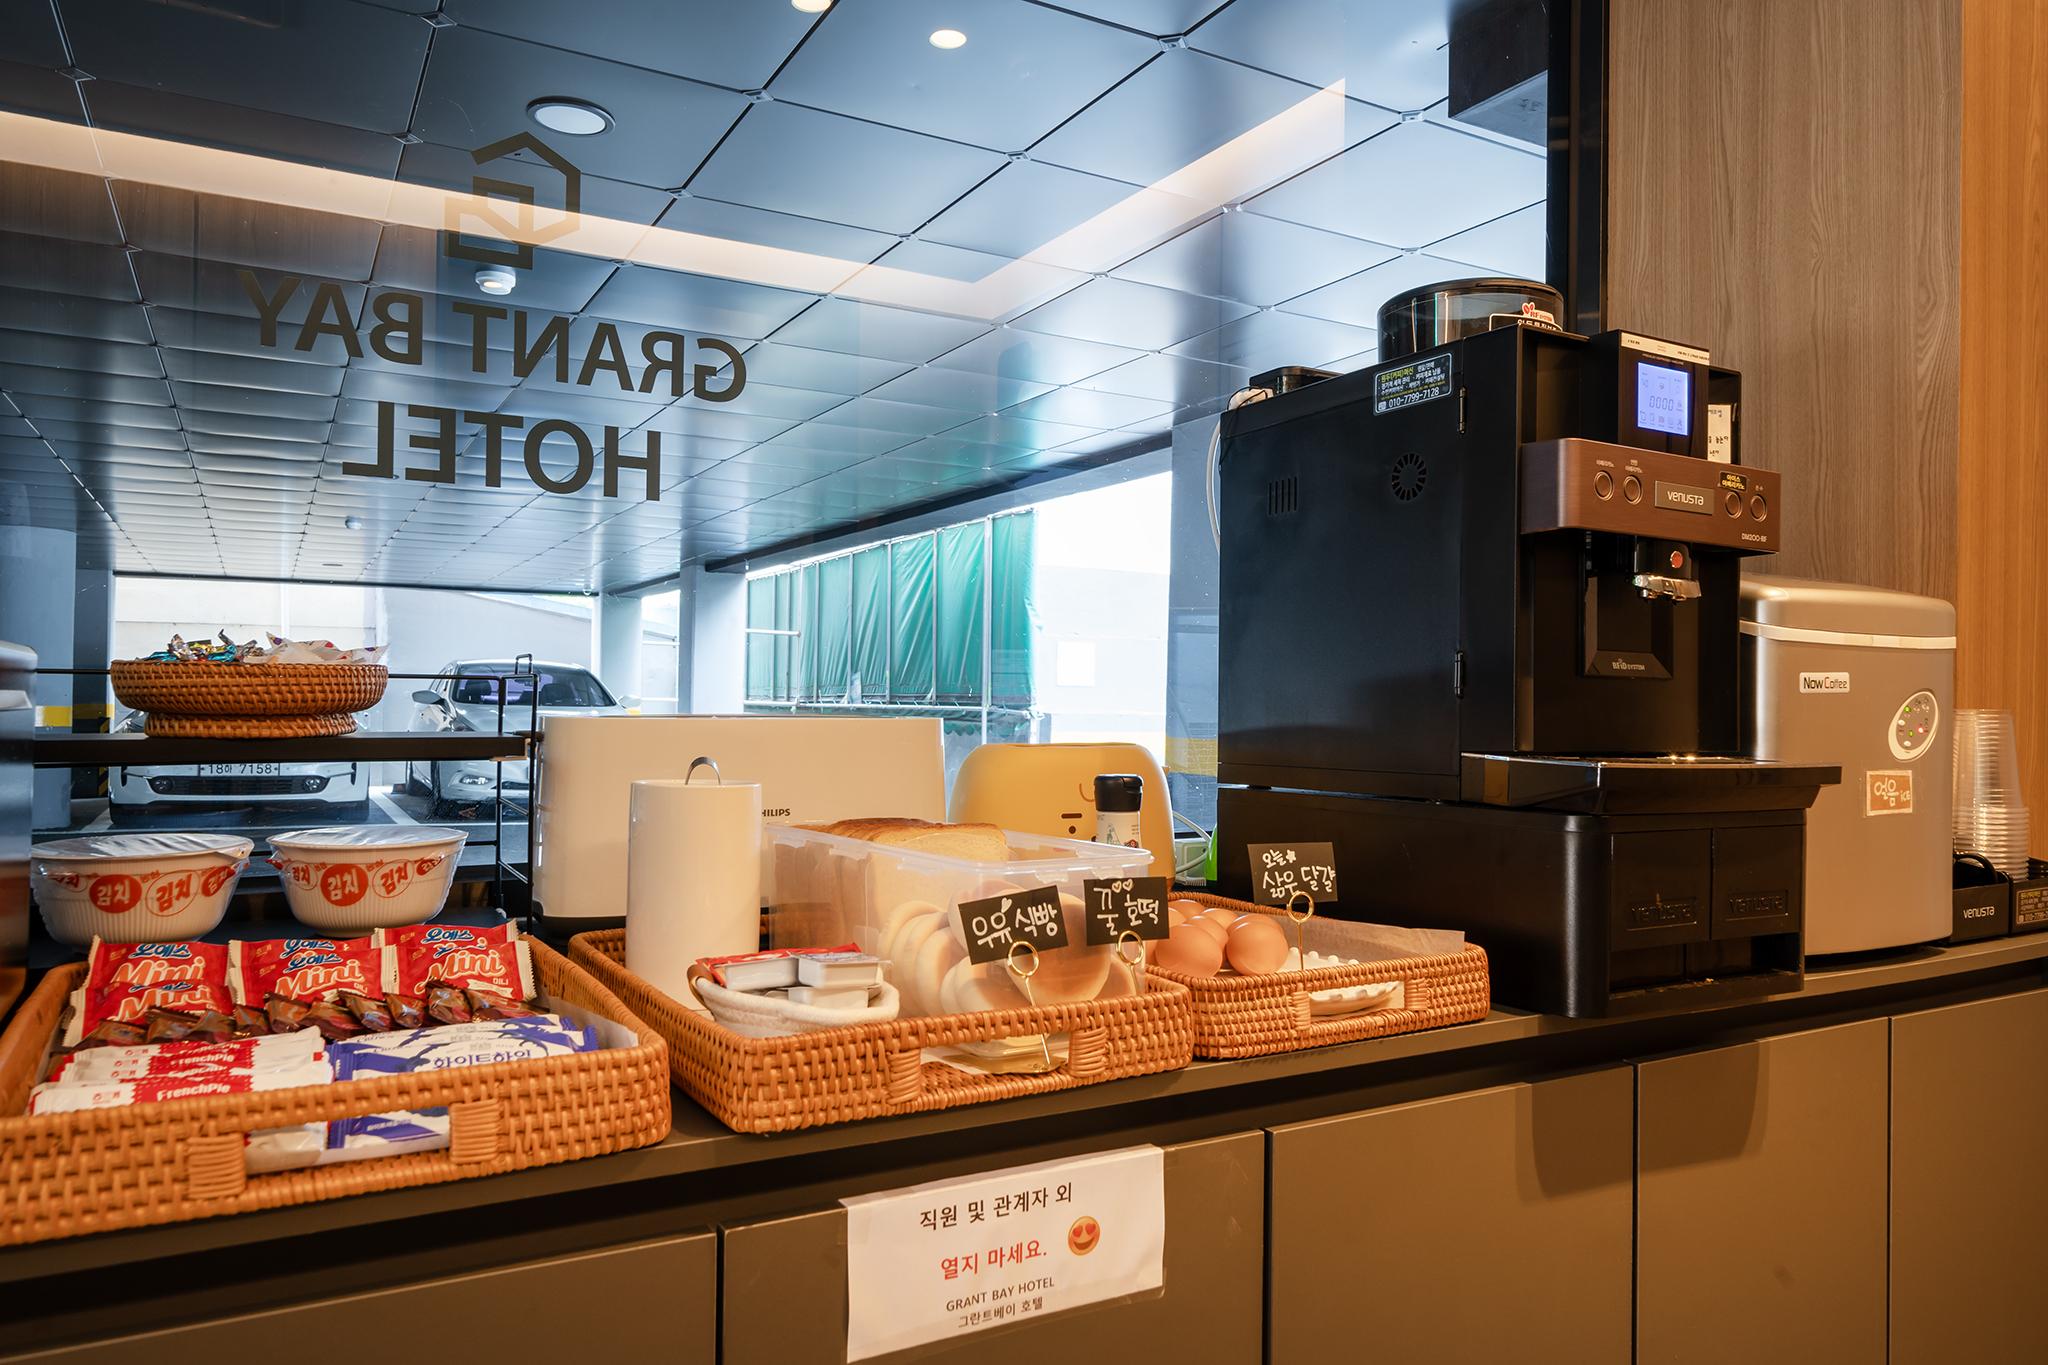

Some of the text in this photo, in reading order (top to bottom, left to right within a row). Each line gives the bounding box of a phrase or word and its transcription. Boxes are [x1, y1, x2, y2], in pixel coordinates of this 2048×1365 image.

[1388, 386, 1440, 408] 010-7799-7128
[1803, 677, 1823, 689] Now
[240, 763, 272, 774] 7158
[1874, 778, 1899, 807] 얼음
[762, 808, 791, 817] HILIPS
[1262, 849, 1286, 869] 오늘
[96, 878, 130, 907] 김치
[156, 869, 193, 914] 김치
[327, 872, 359, 901] 김치
[380, 861, 410, 896] 김치
[1300, 865, 1336, 892] 달걀
[972, 902, 1058, 949] 우유 식빵
[1124, 894, 1159, 927] 호떡
[110, 956, 206, 986] Mini
[274, 959, 365, 1000] Mini
[414, 949, 507, 995] Mini
[157, 1083, 231, 1101] FrenchPie
[920, 1182, 1072, 1231] 직원 및 관계자 외
[941, 1240, 1047, 1280] 열지 마세요.
[946, 1277, 1055, 1312] GRANT BAY HOTEL
[958, 1296, 1043, 1328] 그란트베이 호텔
